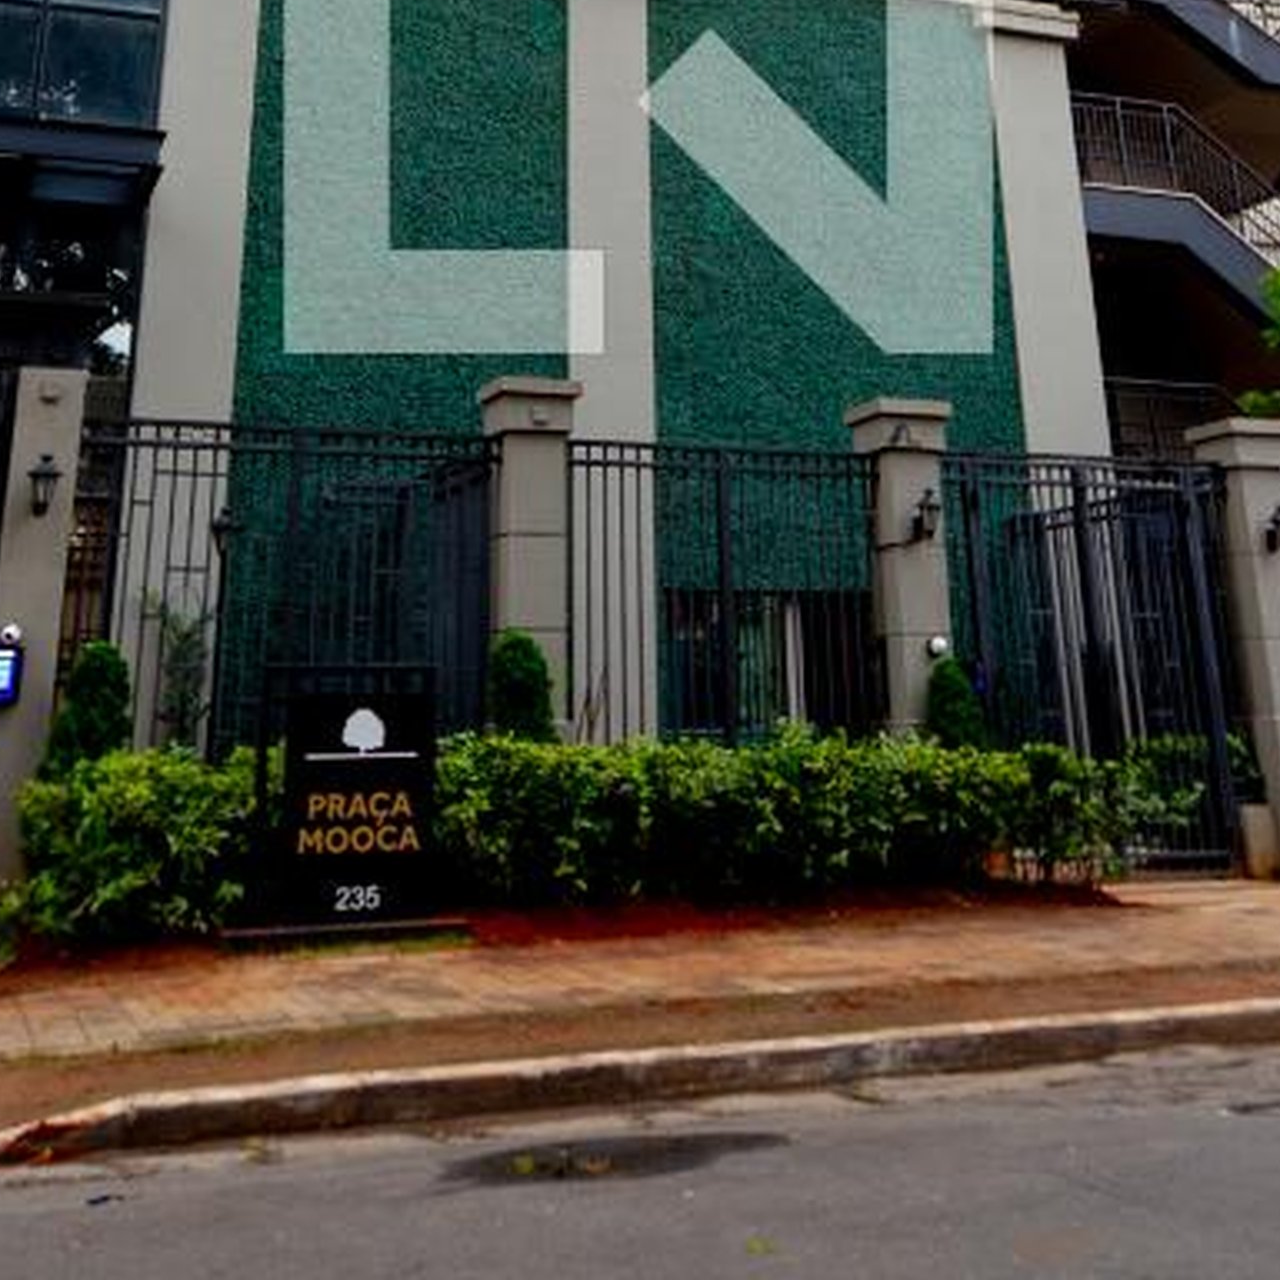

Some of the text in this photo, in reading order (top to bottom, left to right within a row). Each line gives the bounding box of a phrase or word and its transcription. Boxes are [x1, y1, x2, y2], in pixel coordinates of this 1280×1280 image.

[307, 790, 413, 825] PRAÇA
[296, 825, 421, 855] MOOCA
[333, 883, 382, 912] 235
